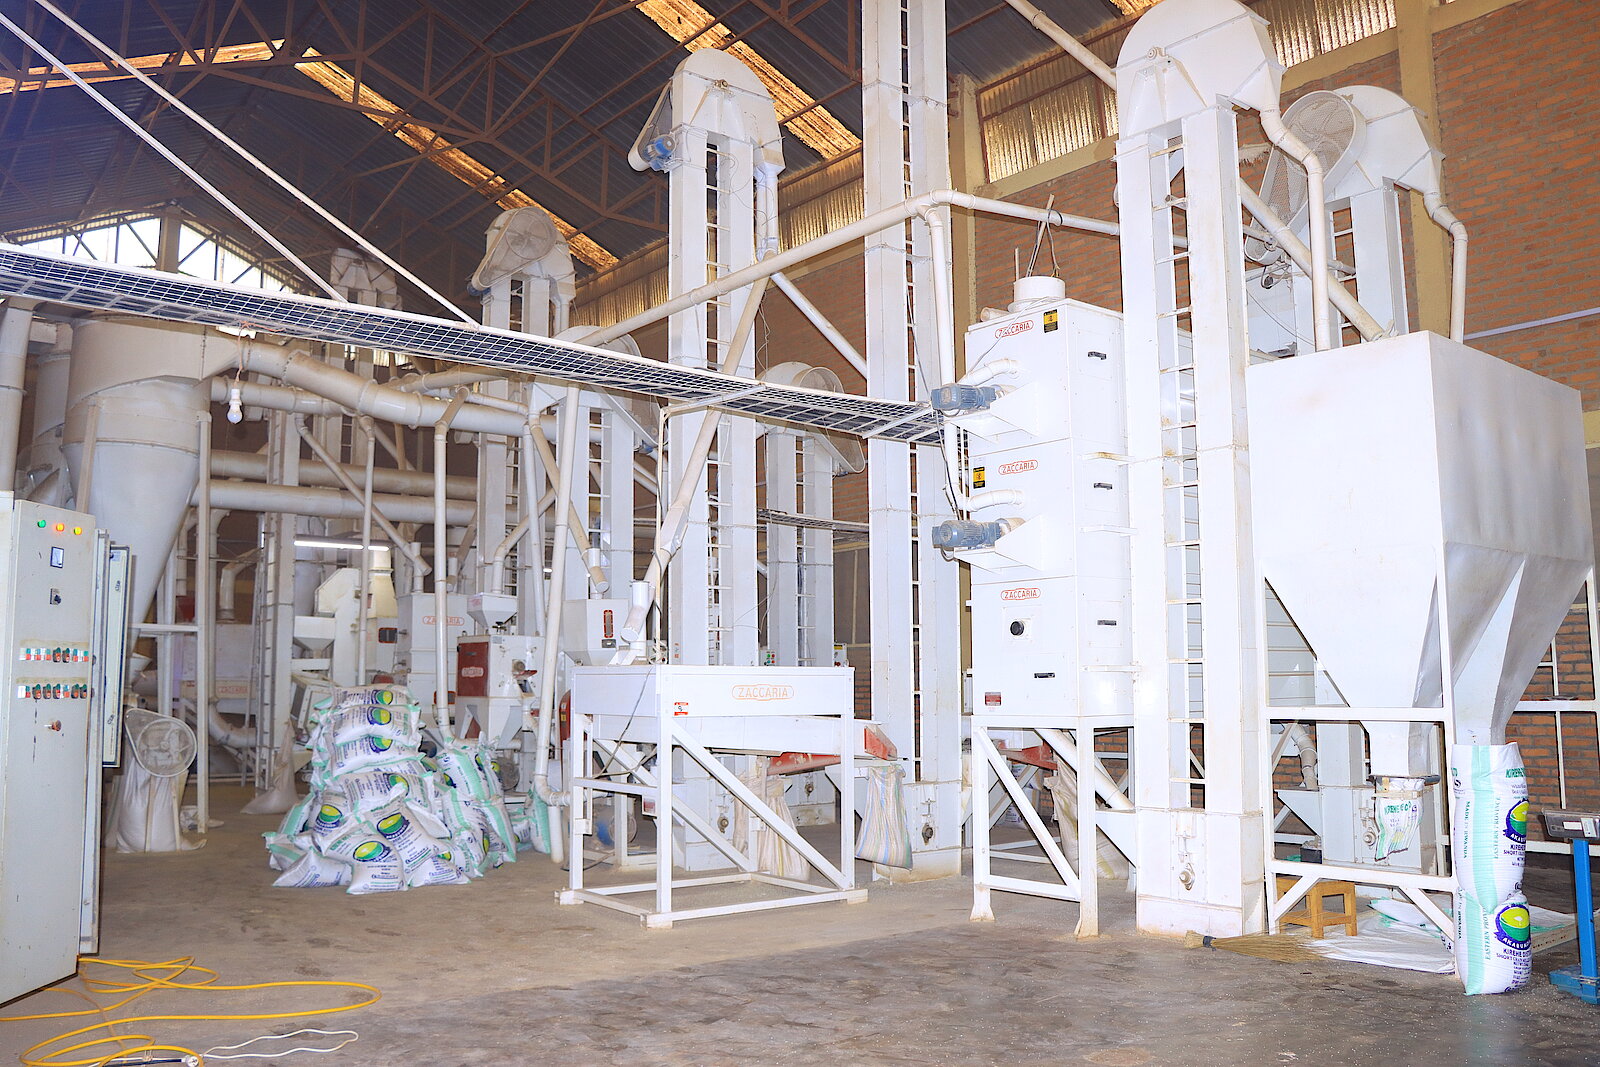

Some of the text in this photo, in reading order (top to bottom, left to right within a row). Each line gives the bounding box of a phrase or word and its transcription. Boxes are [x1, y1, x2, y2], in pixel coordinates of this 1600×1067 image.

[1002, 461, 1035, 474] ZACCARIA
[1004, 589, 1038, 599] ZACCARIA
[738, 687, 788, 698] ZACCARIA
